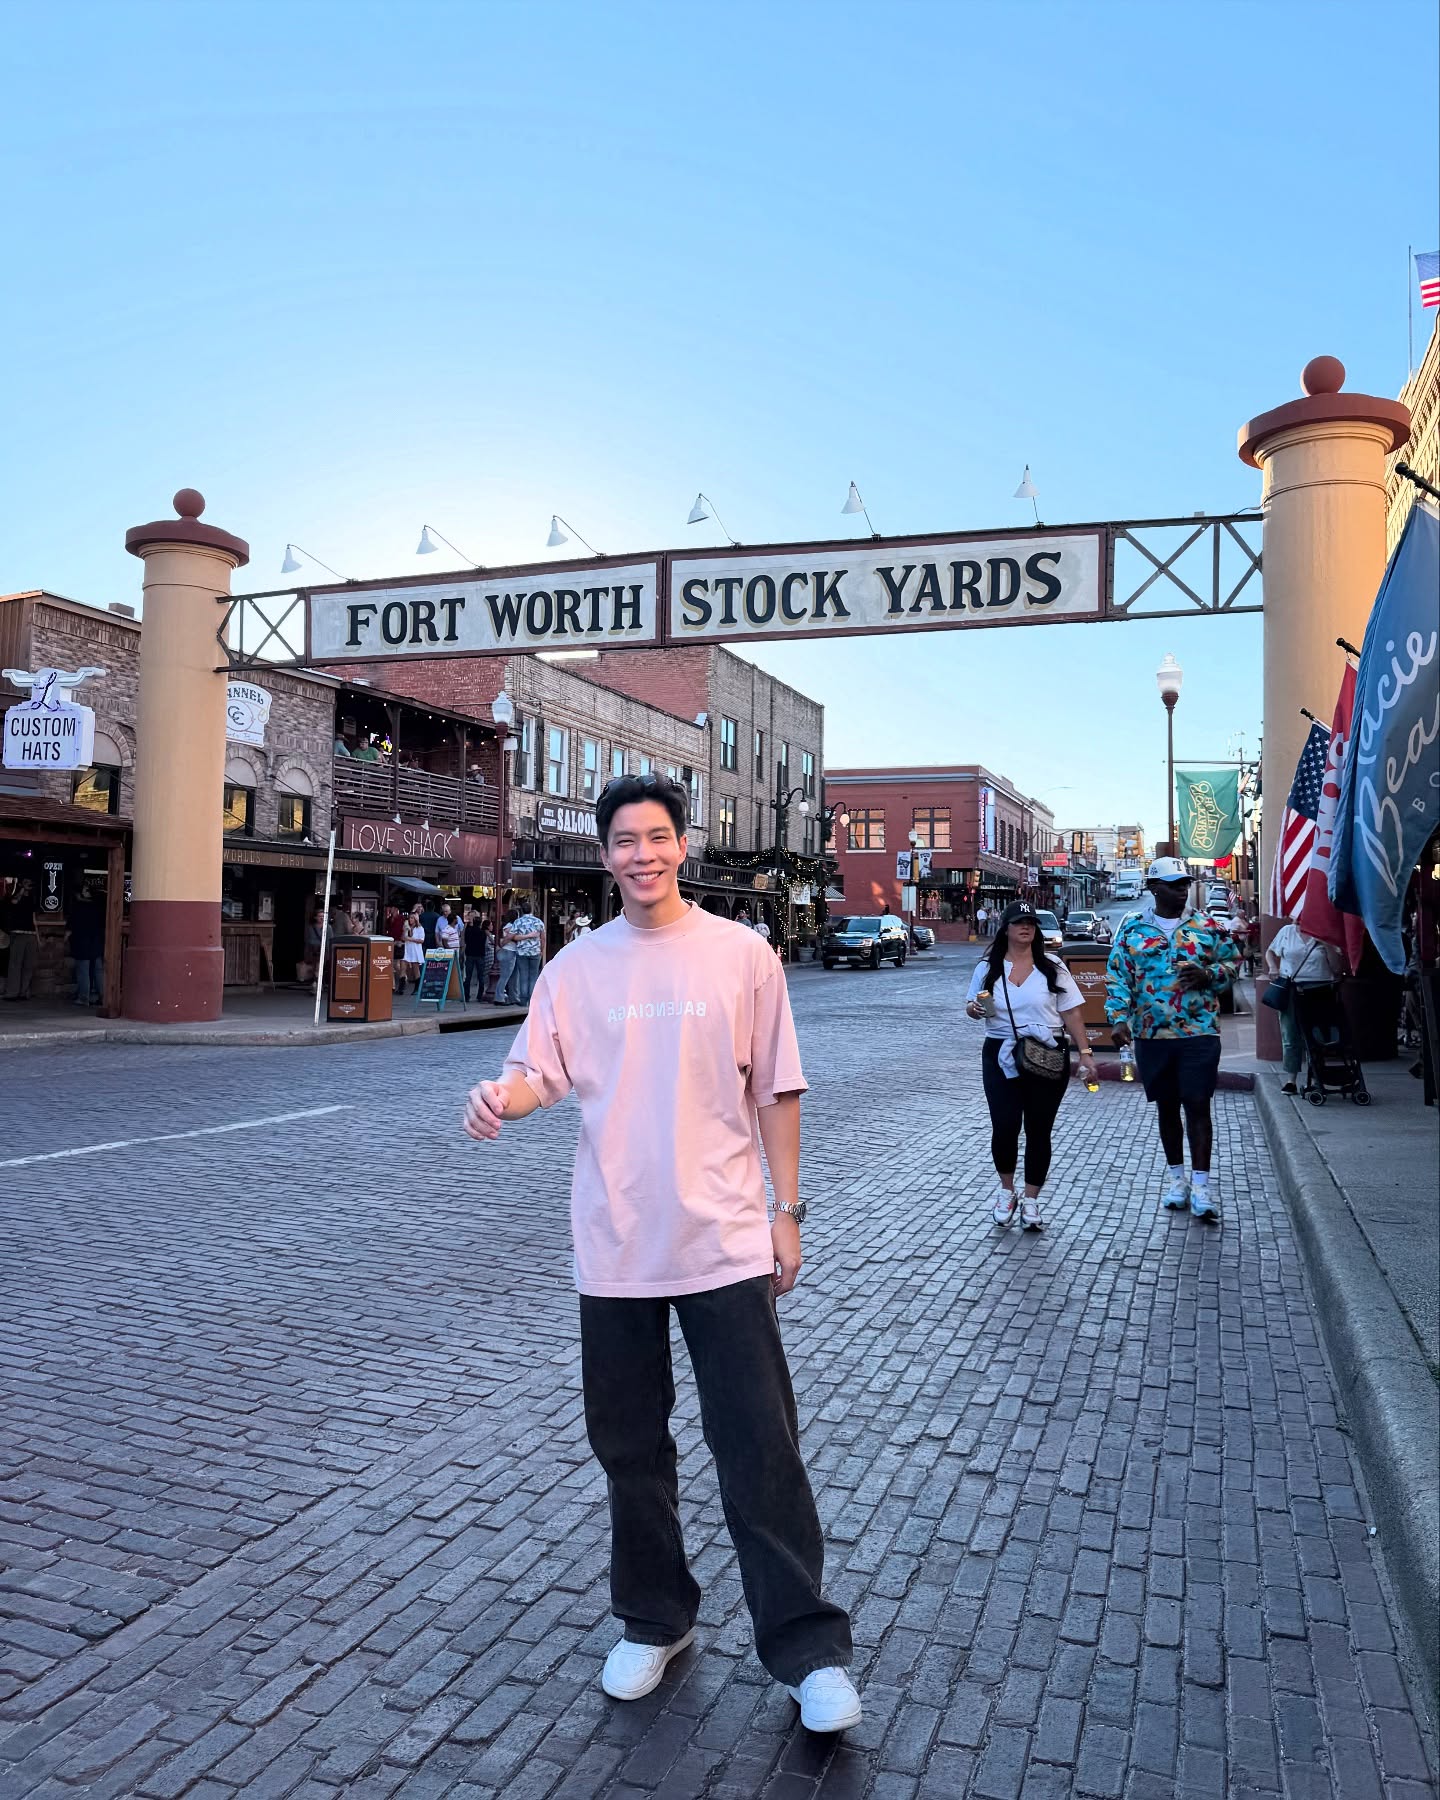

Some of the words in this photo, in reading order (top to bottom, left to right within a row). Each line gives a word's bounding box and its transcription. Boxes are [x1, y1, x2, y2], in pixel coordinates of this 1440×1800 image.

[345, 598, 465, 647] FORT
[484, 584, 644, 638] WORTH
[681, 569, 850, 628] STOCK
[876, 551, 1063, 614] YARDS
[11, 717, 76, 737] CUSTOM
[21, 741, 61, 761] HATS
[402, 829, 453, 859] SHACK
[43, 862, 64, 871] OPEN
